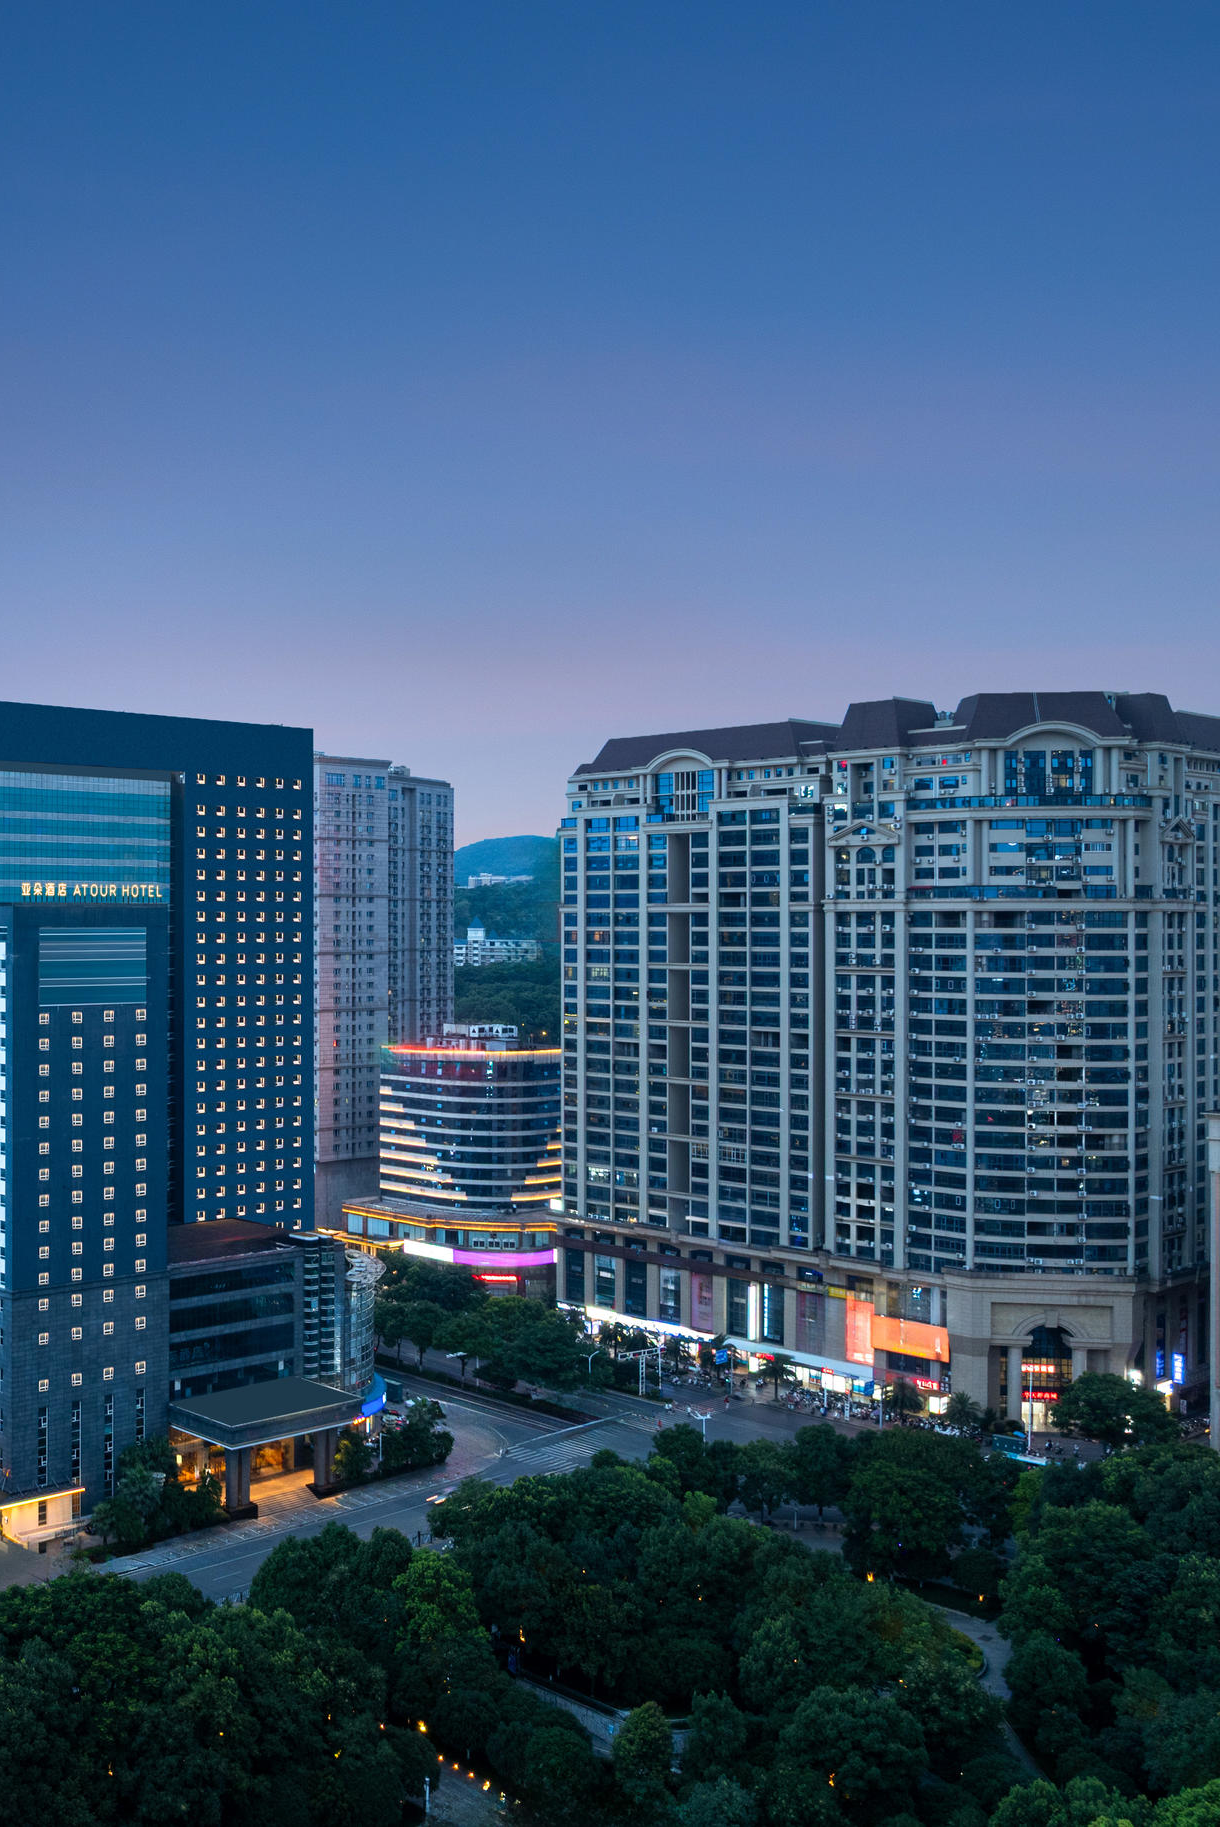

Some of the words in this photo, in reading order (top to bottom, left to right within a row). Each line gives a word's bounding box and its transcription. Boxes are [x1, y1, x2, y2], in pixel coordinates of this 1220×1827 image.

[21, 882, 67, 897] 亚朵酒店
[73, 883, 117, 897] ATOUR
[121, 884, 163, 898] HOTEL
